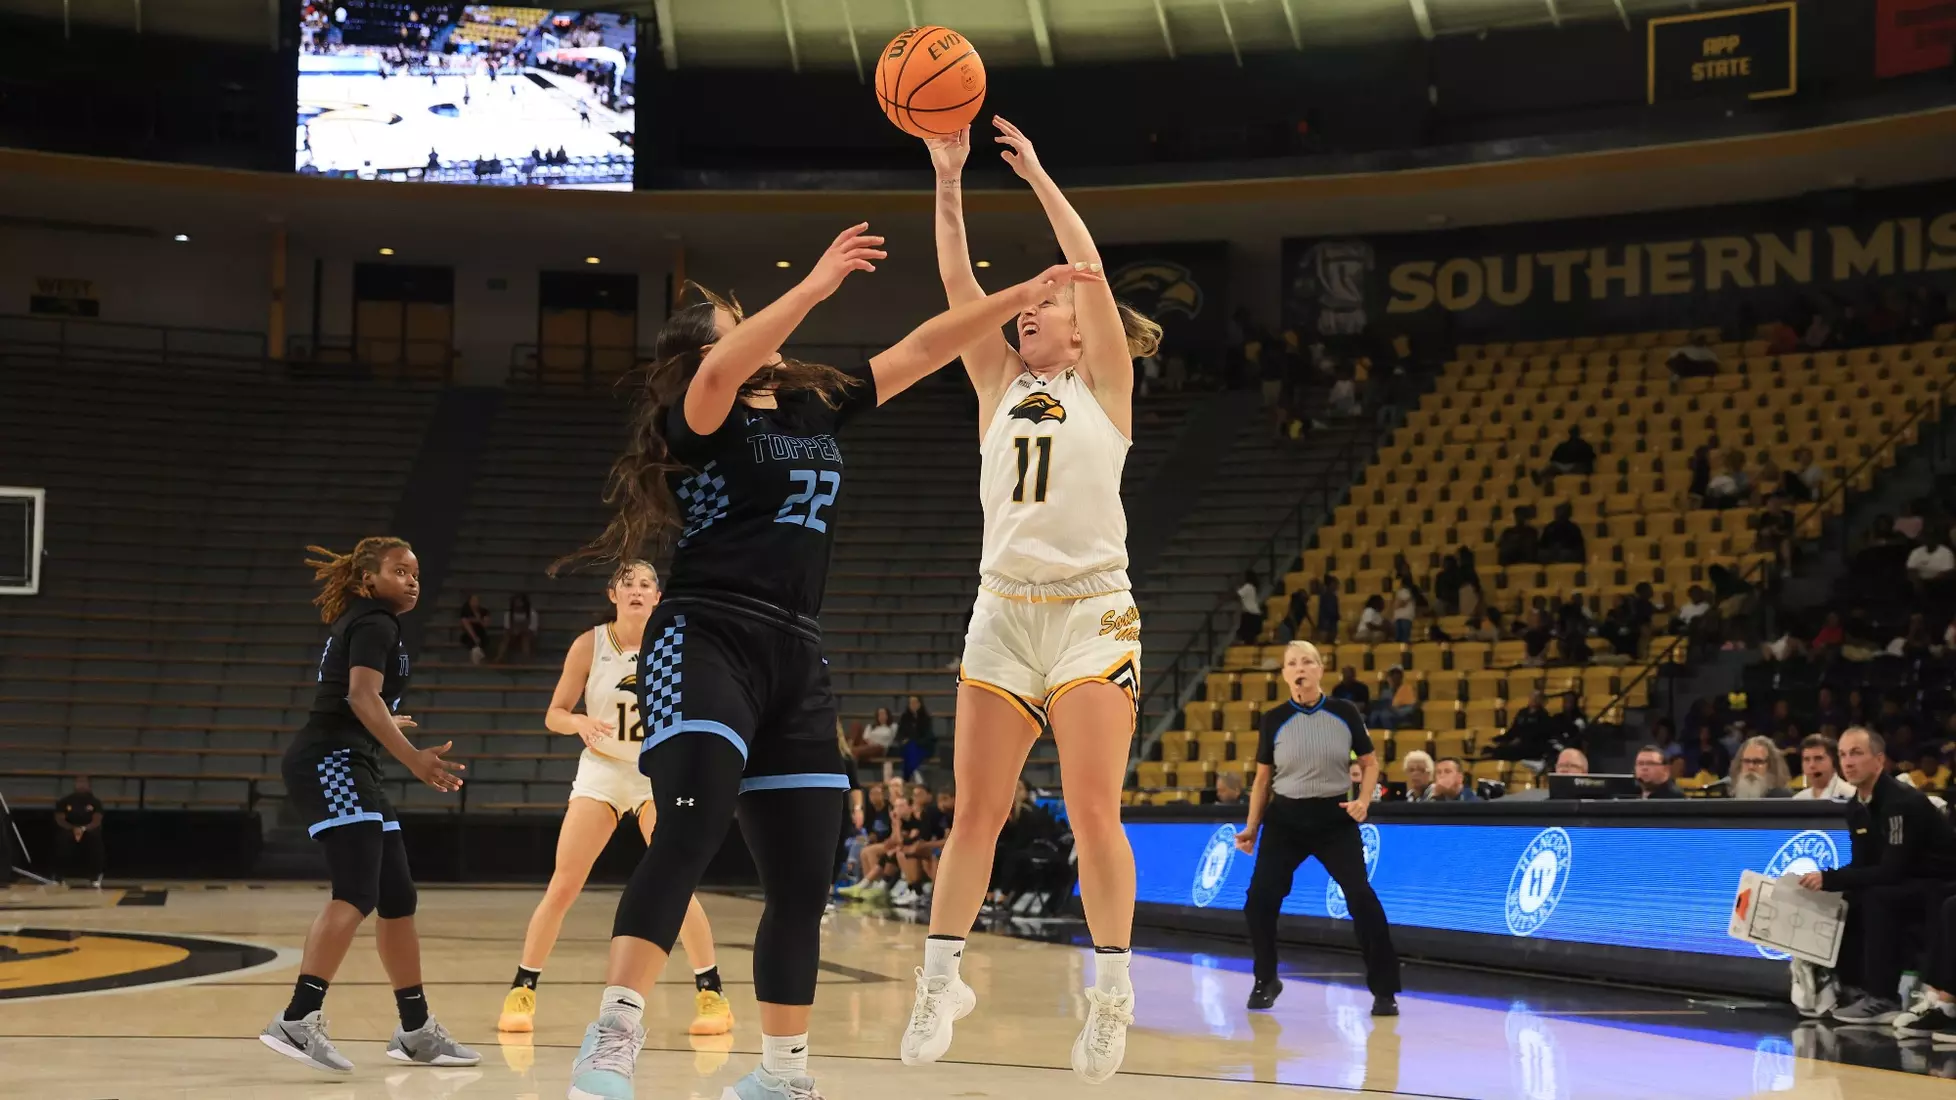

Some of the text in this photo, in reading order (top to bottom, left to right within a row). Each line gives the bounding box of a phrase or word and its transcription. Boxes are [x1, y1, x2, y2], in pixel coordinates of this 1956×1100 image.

[1703, 34, 1741, 57] APP
[1691, 56, 1752, 82] STATE
[1386, 229, 1813, 313] SOUTHERN
[1012, 436, 1052, 504] 11
[774, 470, 841, 534] 22
[616, 702, 645, 742] 12
[1519, 833, 1569, 872] HANCOCK
[1767, 838, 1834, 879] HANCOC
